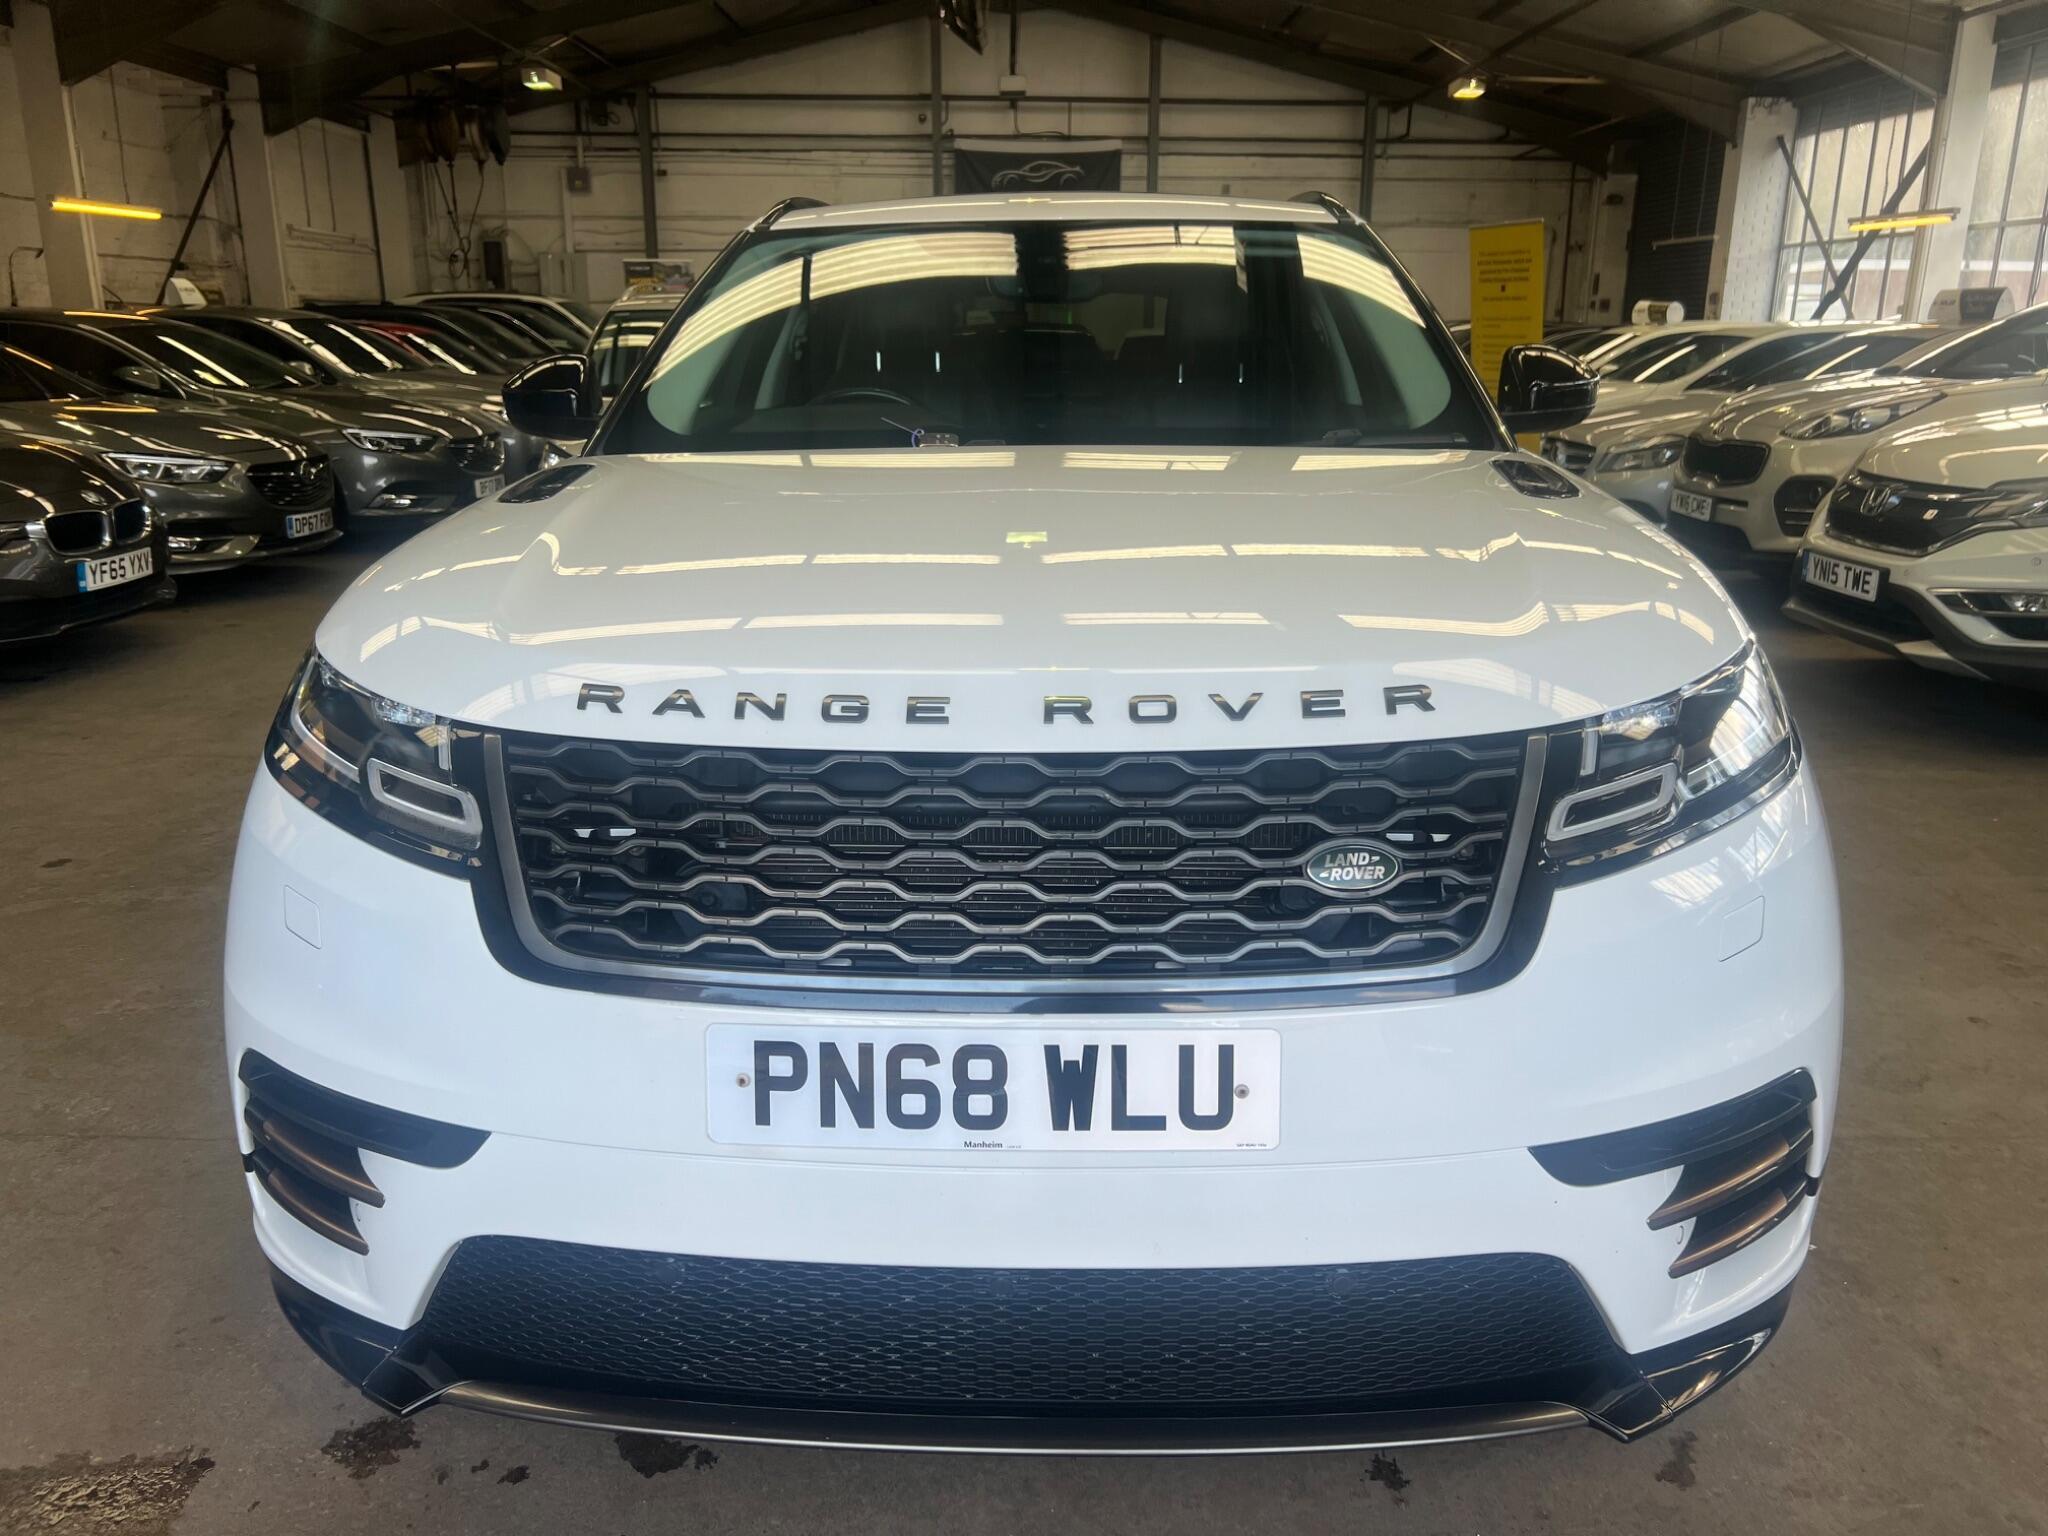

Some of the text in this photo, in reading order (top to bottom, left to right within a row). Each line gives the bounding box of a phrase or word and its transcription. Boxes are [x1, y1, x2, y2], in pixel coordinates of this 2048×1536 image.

[294, 513, 318, 534] DP67
[89, 551, 149, 585] YF65 YXV
[1812, 556, 1873, 595] YN15 TWE
[576, 682, 1436, 725] RANGE ROVER
[1324, 852, 1369, 868] LAND
[1330, 865, 1385, 881] ROVER
[753, 1040, 1235, 1132] PN68 WLU
[963, 1140, 1003, 1149] Manheim
